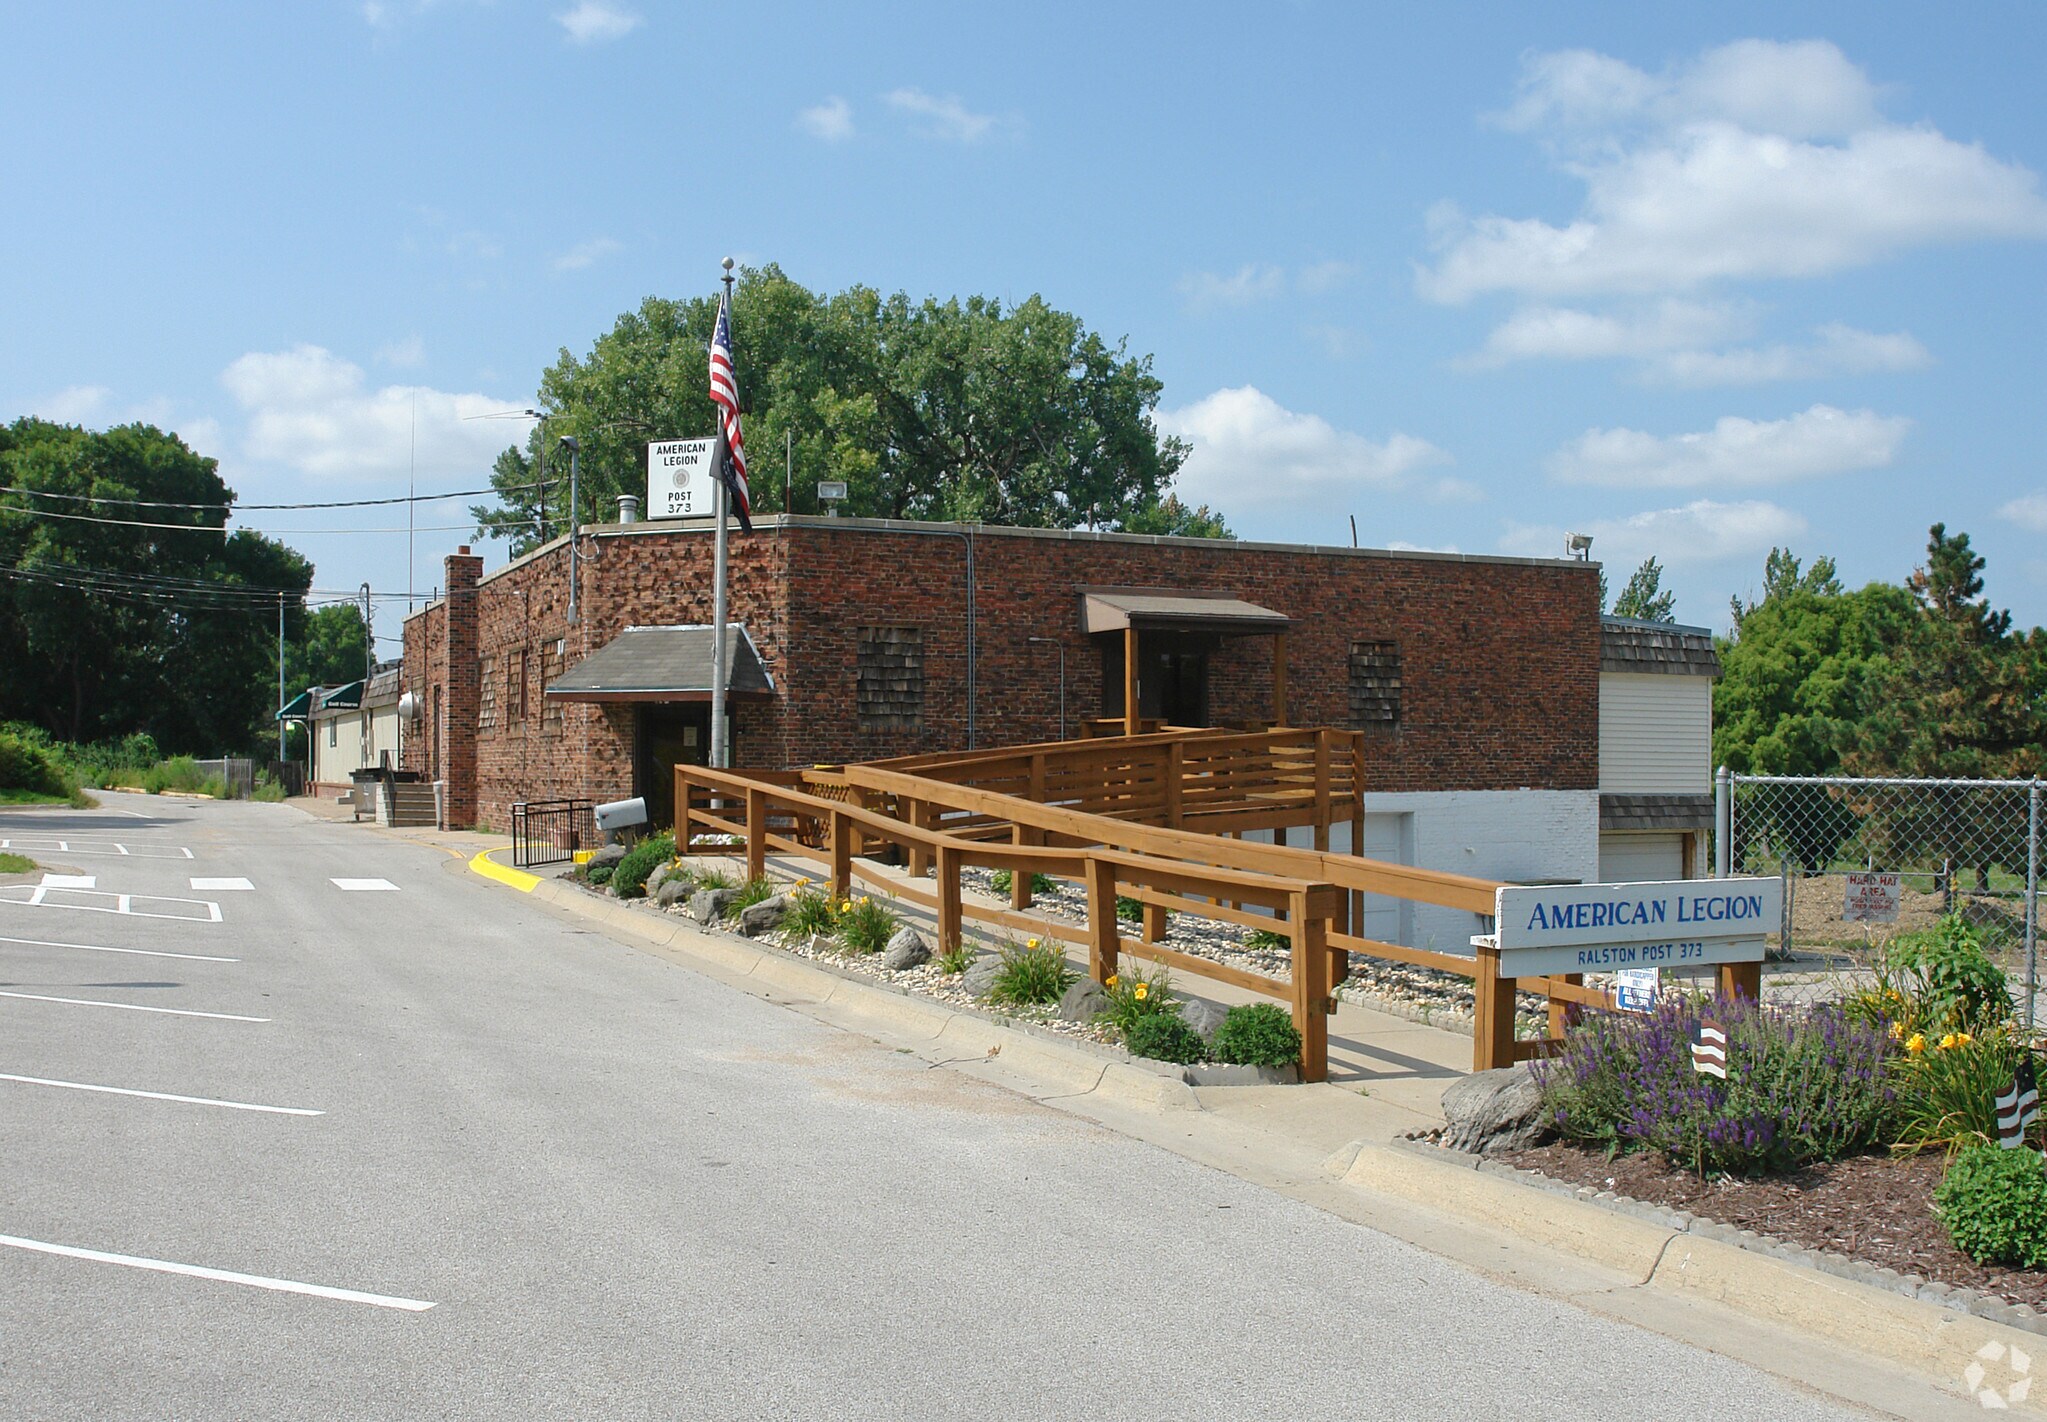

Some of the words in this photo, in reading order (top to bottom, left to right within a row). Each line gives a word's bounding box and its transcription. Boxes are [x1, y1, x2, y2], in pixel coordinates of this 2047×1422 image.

[656, 443, 706, 455] AMERICAN
[663, 455, 698, 466] LEGION
[668, 491, 692, 501] POST
[668, 503, 692, 513] 373
[1850, 876, 1877, 885] HARD
[1880, 876, 1898, 886] HAT
[1861, 887, 1886, 897] AREA
[1527, 900, 1666, 930] AMERICAN
[1677, 896, 1762, 923] LEGION
[1578, 947, 1636, 965] RALSTON
[1642, 944, 1673, 961] POST
[1680, 942, 1703, 959] 373
